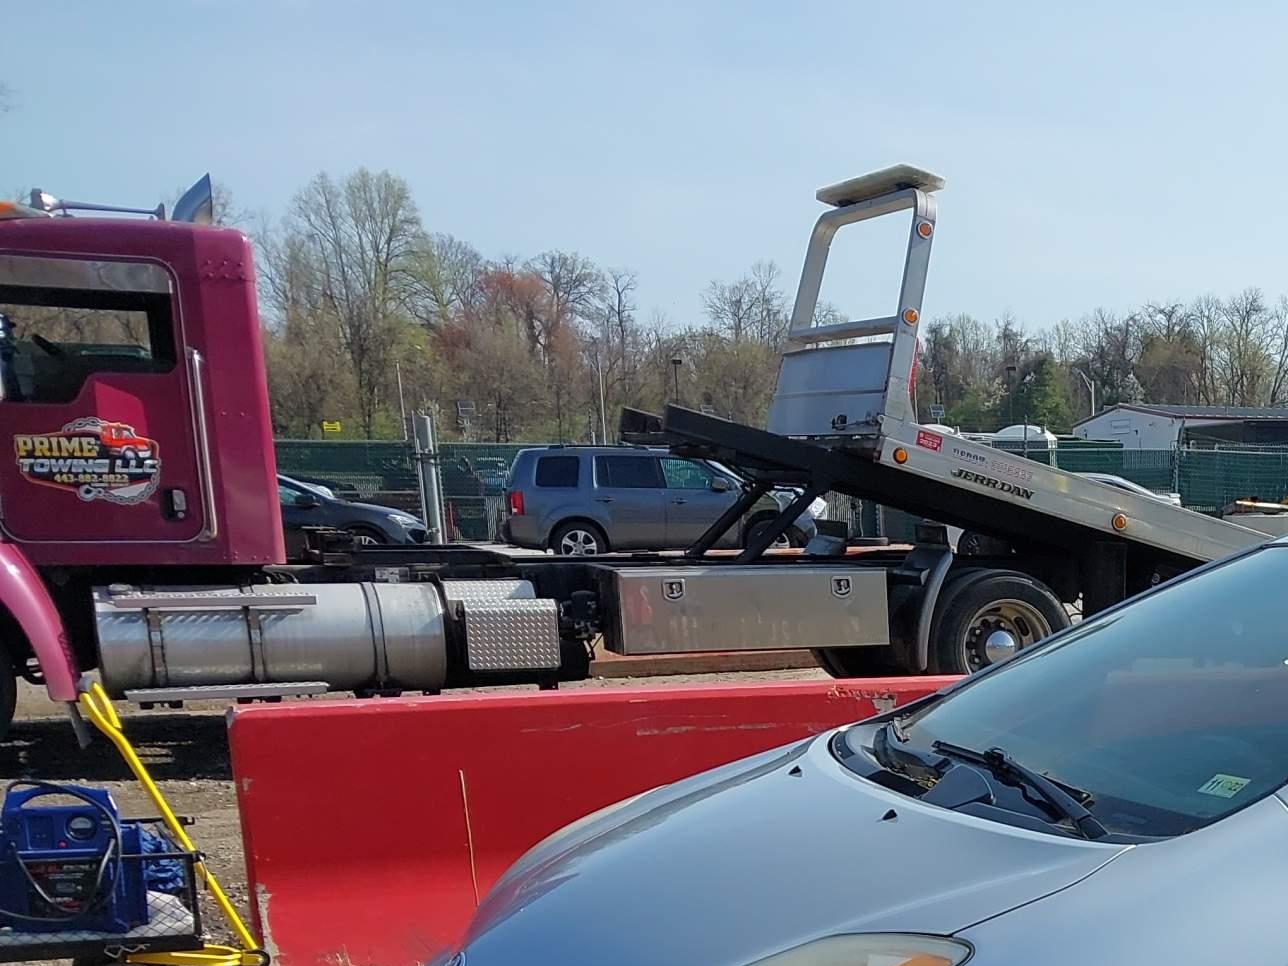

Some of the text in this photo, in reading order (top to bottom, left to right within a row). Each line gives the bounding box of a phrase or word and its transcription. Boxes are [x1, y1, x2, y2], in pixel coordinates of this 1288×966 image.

[16, 436, 98, 457] PRIME
[19, 458, 158, 473] TOWING LLC
